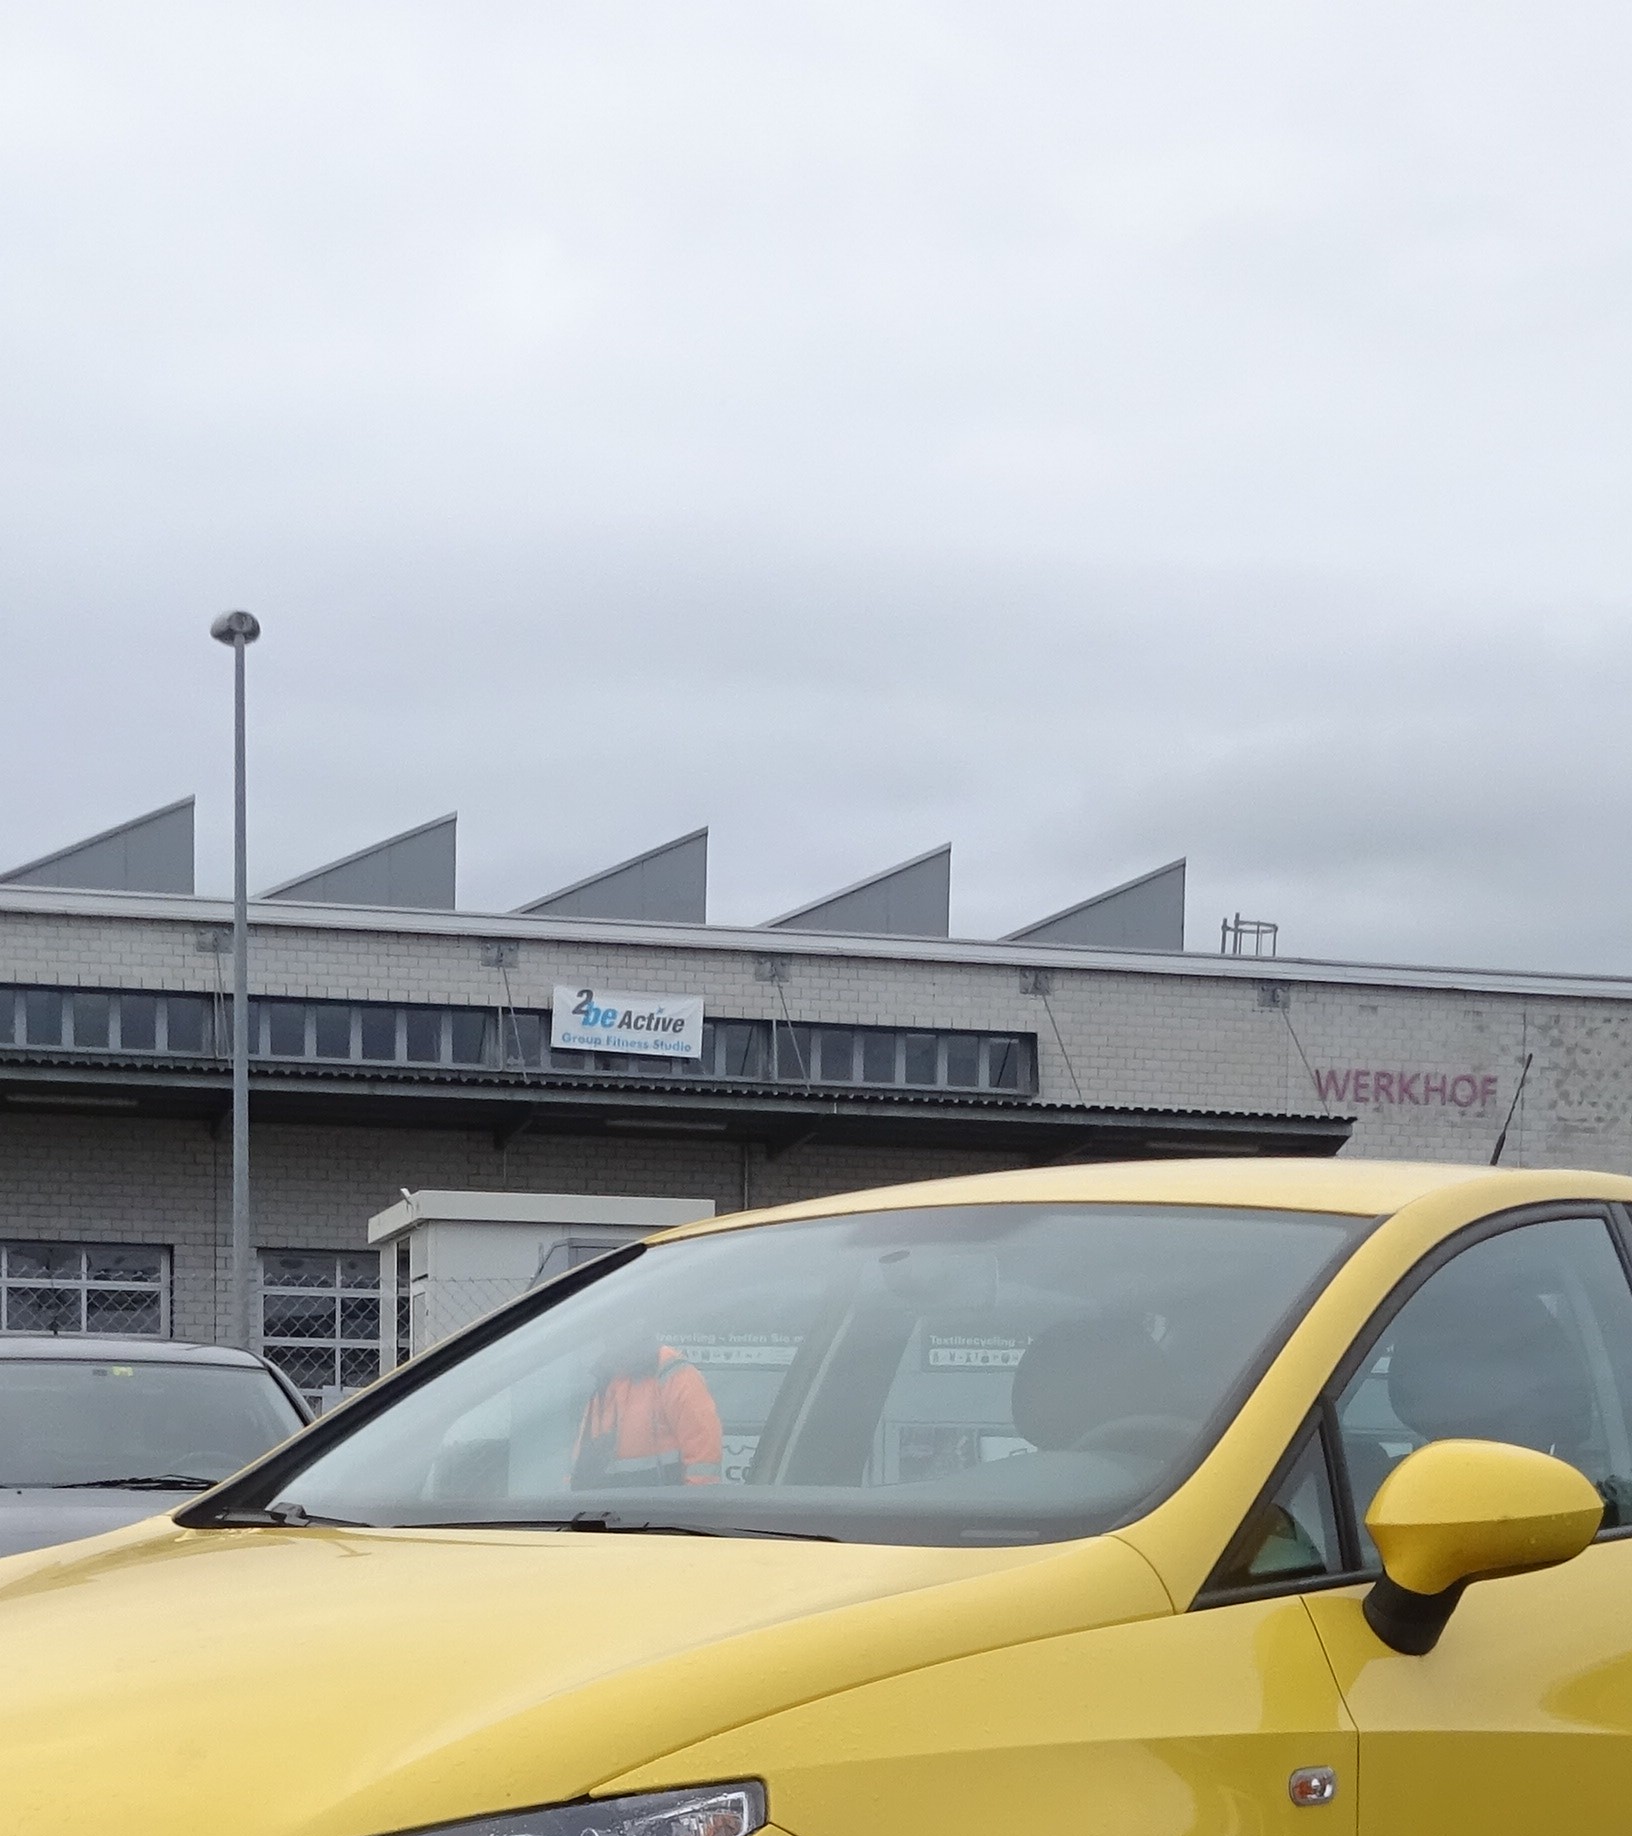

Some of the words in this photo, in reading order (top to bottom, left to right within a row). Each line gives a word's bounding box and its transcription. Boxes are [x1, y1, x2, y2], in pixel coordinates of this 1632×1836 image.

[618, 1006, 685, 1033] Active
[561, 1032, 601, 1046] Group
[606, 1035, 649, 1050] Fitness
[653, 1039, 692, 1053] Studio
[1314, 1068, 1498, 1107] WERKHOF
